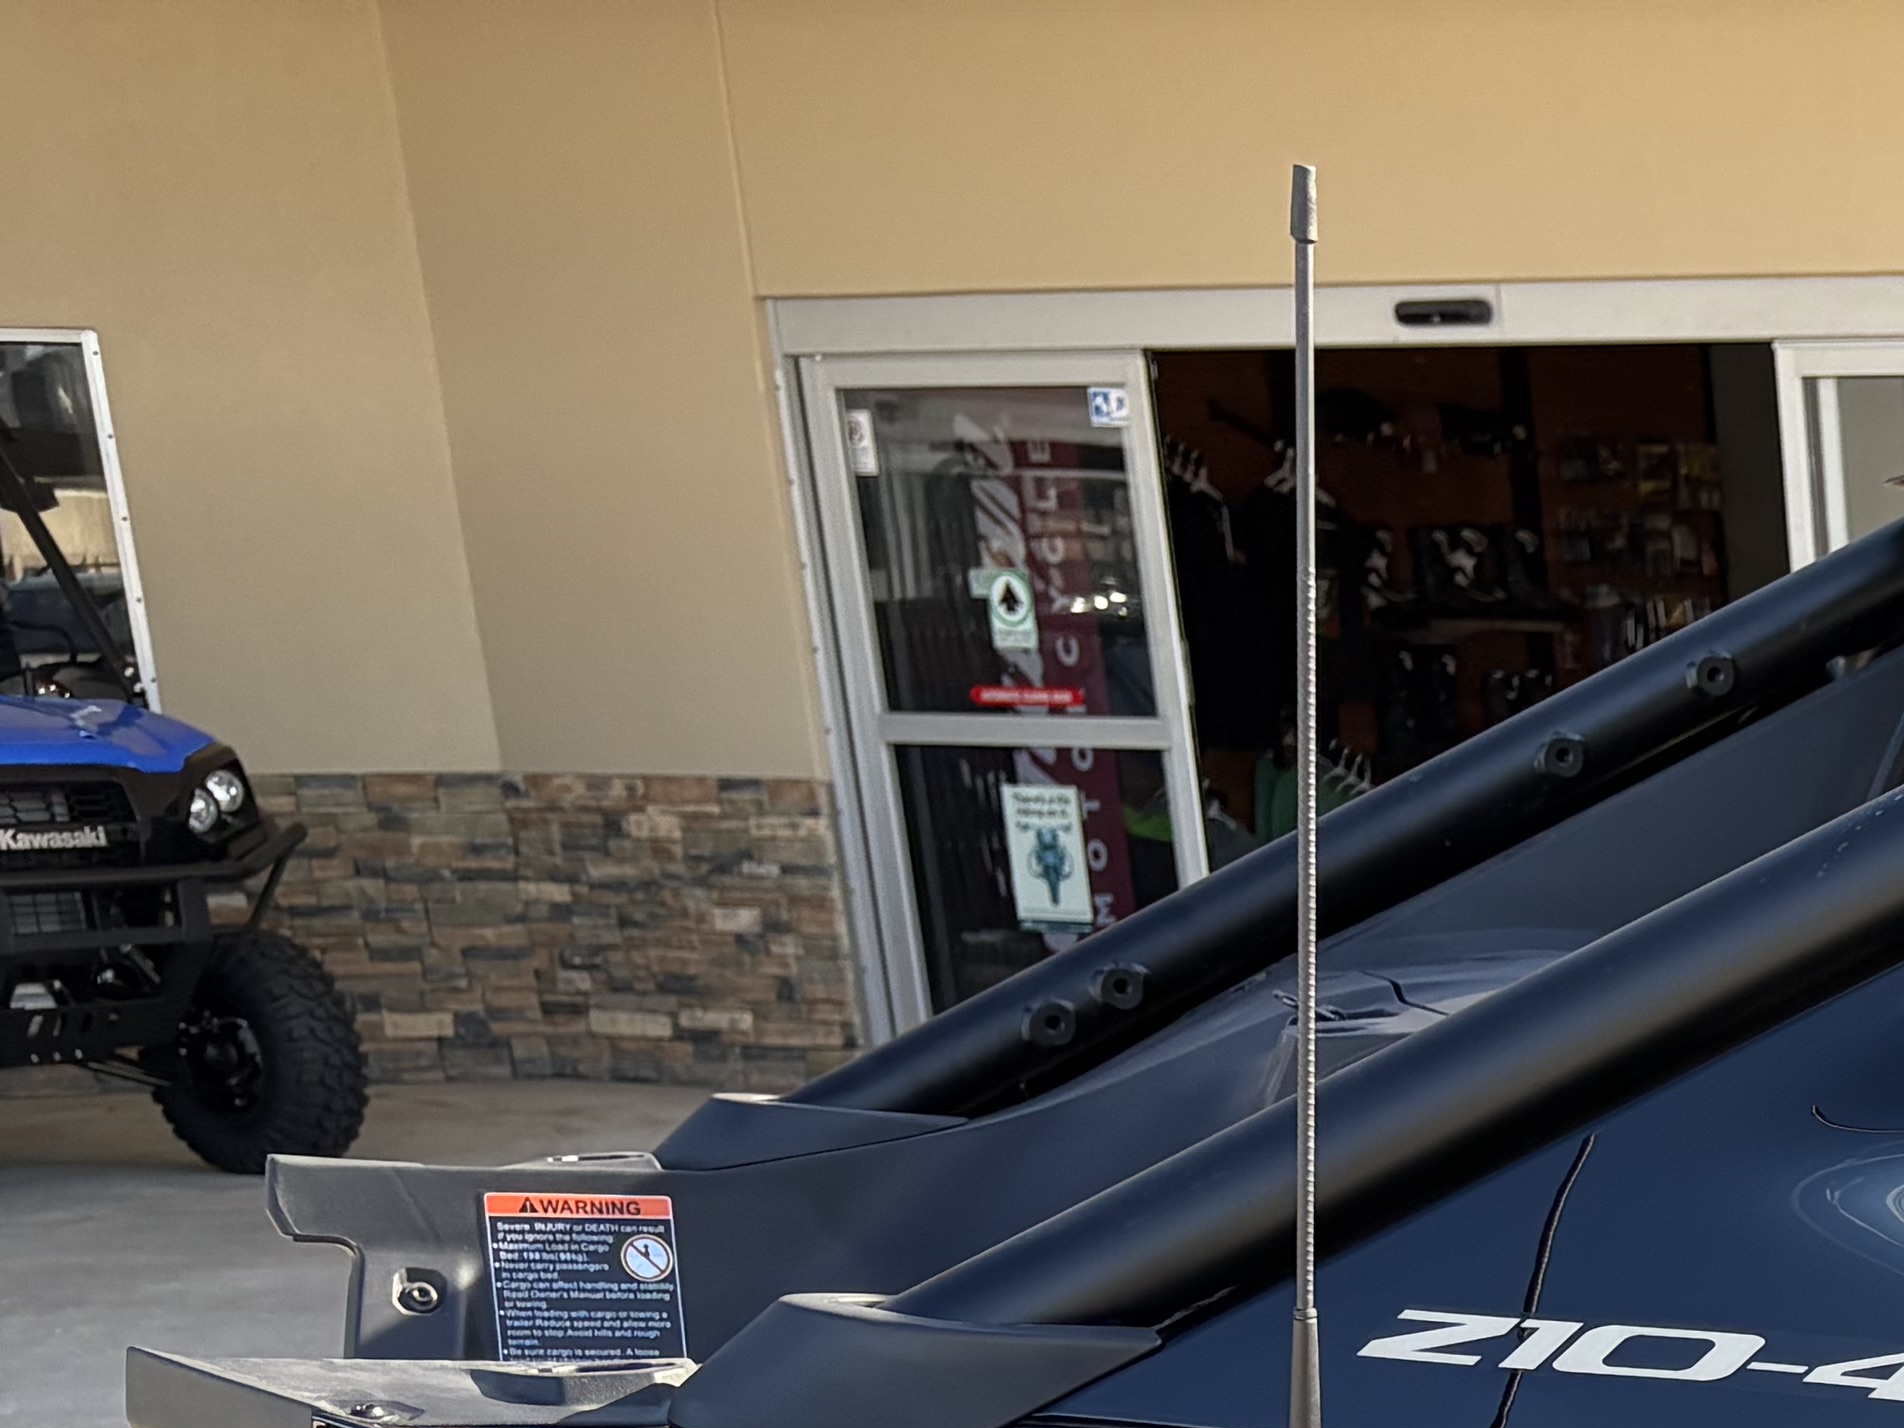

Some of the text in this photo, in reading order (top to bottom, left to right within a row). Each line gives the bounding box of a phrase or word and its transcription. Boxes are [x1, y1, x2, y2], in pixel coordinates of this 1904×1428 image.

[0, 826, 107, 850] Kawasaki
[539, 1199, 641, 1216] WARNING
[534, 1222, 571, 1232] INJURY
[584, 1223, 618, 1232] DEATH
[580, 1243, 609, 1253] Cargo
